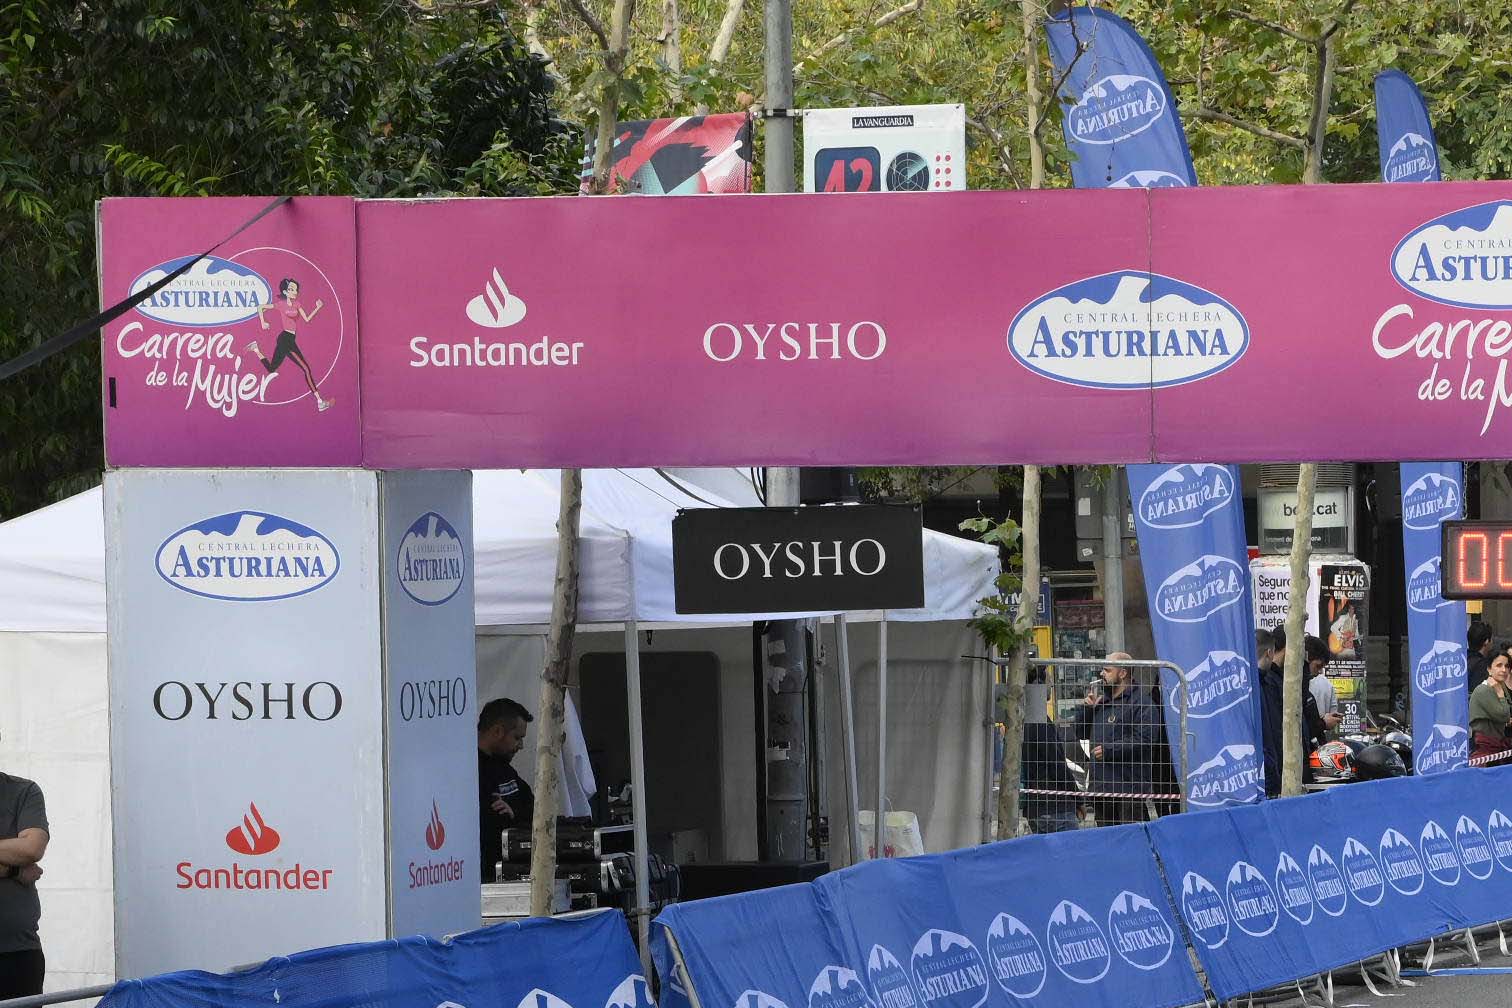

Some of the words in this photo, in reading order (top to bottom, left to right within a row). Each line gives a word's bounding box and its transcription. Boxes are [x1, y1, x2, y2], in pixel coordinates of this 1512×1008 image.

[140, 281, 260, 308] ASTURIANA
[210, 278, 256, 287] LECHERA
[1064, 312, 1139, 324] CENTRAL
[1148, 310, 1223, 323] LECHERA
[116, 321, 234, 359] Carrera
[410, 335, 584, 367] Santander
[703, 321, 887, 362] OYSHO
[1027, 315, 1231, 359] ASTURIANA
[146, 360, 167, 386] de
[172, 359, 188, 386] la
[185, 356, 279, 418] Mujer
[1417, 361, 1453, 401] de
[1460, 359, 1485, 400] la
[170, 545, 327, 578] ASTURIANA
[198, 542, 257, 551] CENTRAL
[262, 541, 321, 551] LECHERA
[712, 538, 887, 580] OYSHO
[403, 546, 461, 583] ASTURIANA
[1259, 590, 1276, 601] que
[1333, 574, 1365, 588] ELVIS
[152, 680, 343, 721] OYSHO
[400, 677, 467, 721] OYSHO
[1344, 703, 1357, 715] 30
[175, 861, 333, 891] Santander
[408, 857, 464, 889] Santander
[993, 950, 1044, 980] ASTURIANA
[1053, 934, 1107, 966] ASTURIANA
[916, 963, 987, 1002] ASTURIANA
